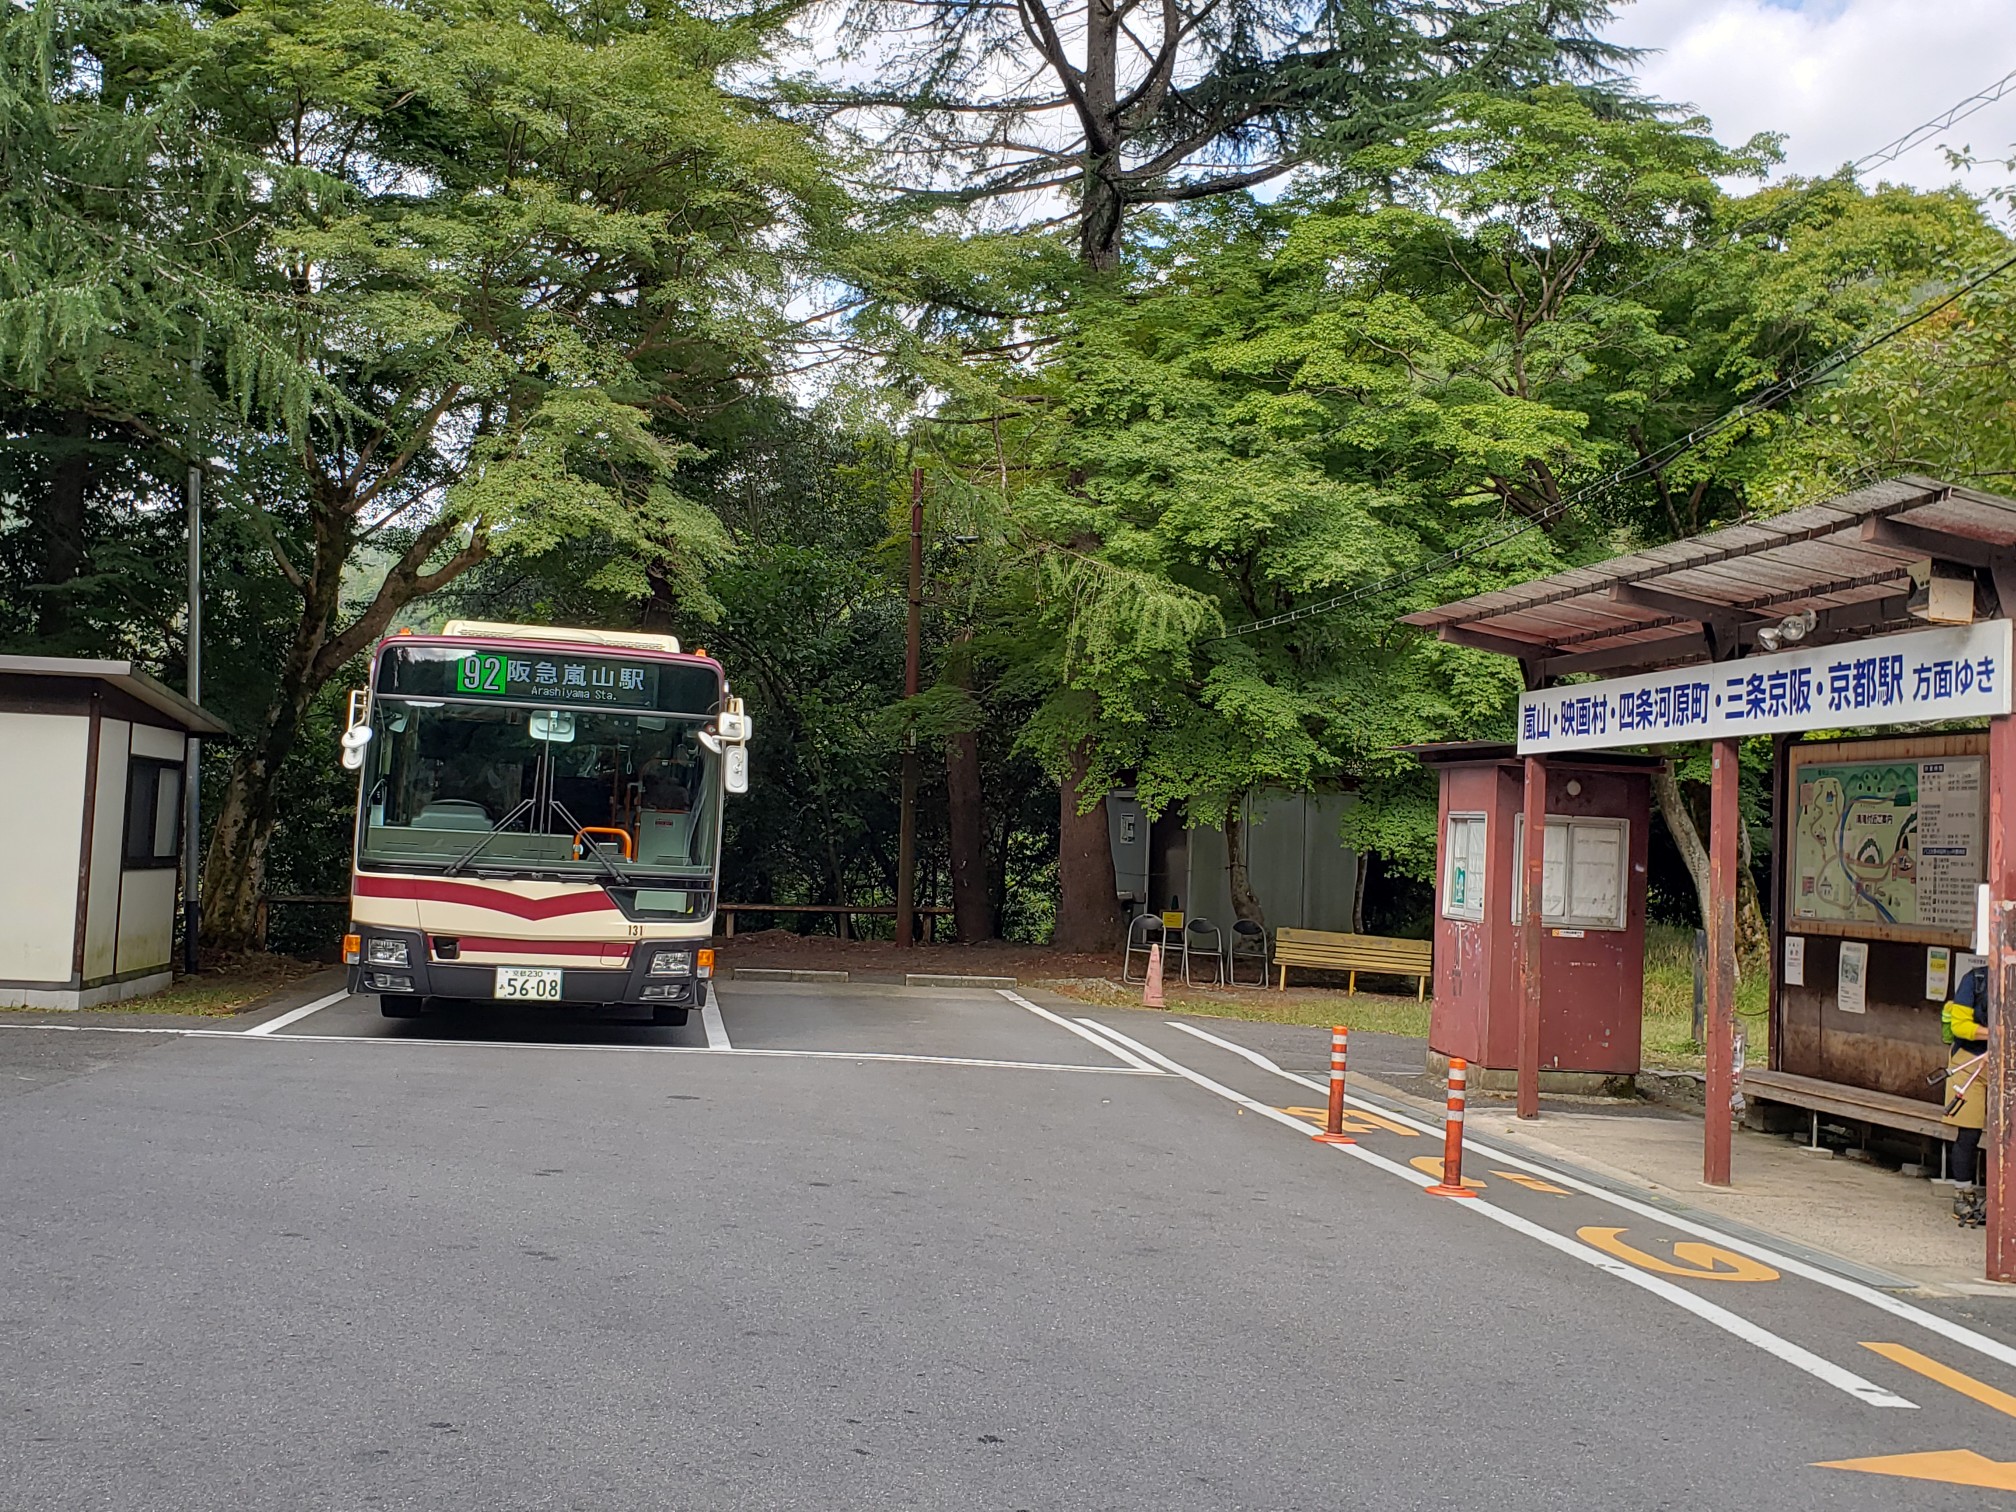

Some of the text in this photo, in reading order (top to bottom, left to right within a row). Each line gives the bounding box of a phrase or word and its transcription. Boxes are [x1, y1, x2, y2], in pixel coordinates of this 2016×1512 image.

[463, 656, 645, 691] 92 阪急嵐山駅
[1912, 655, 1996, 702] 方面ゆき
[531, 685, 617, 701] Arashiyama Sta.
[628, 925, 643, 936] 131
[507, 978, 558, 998] 56-08
